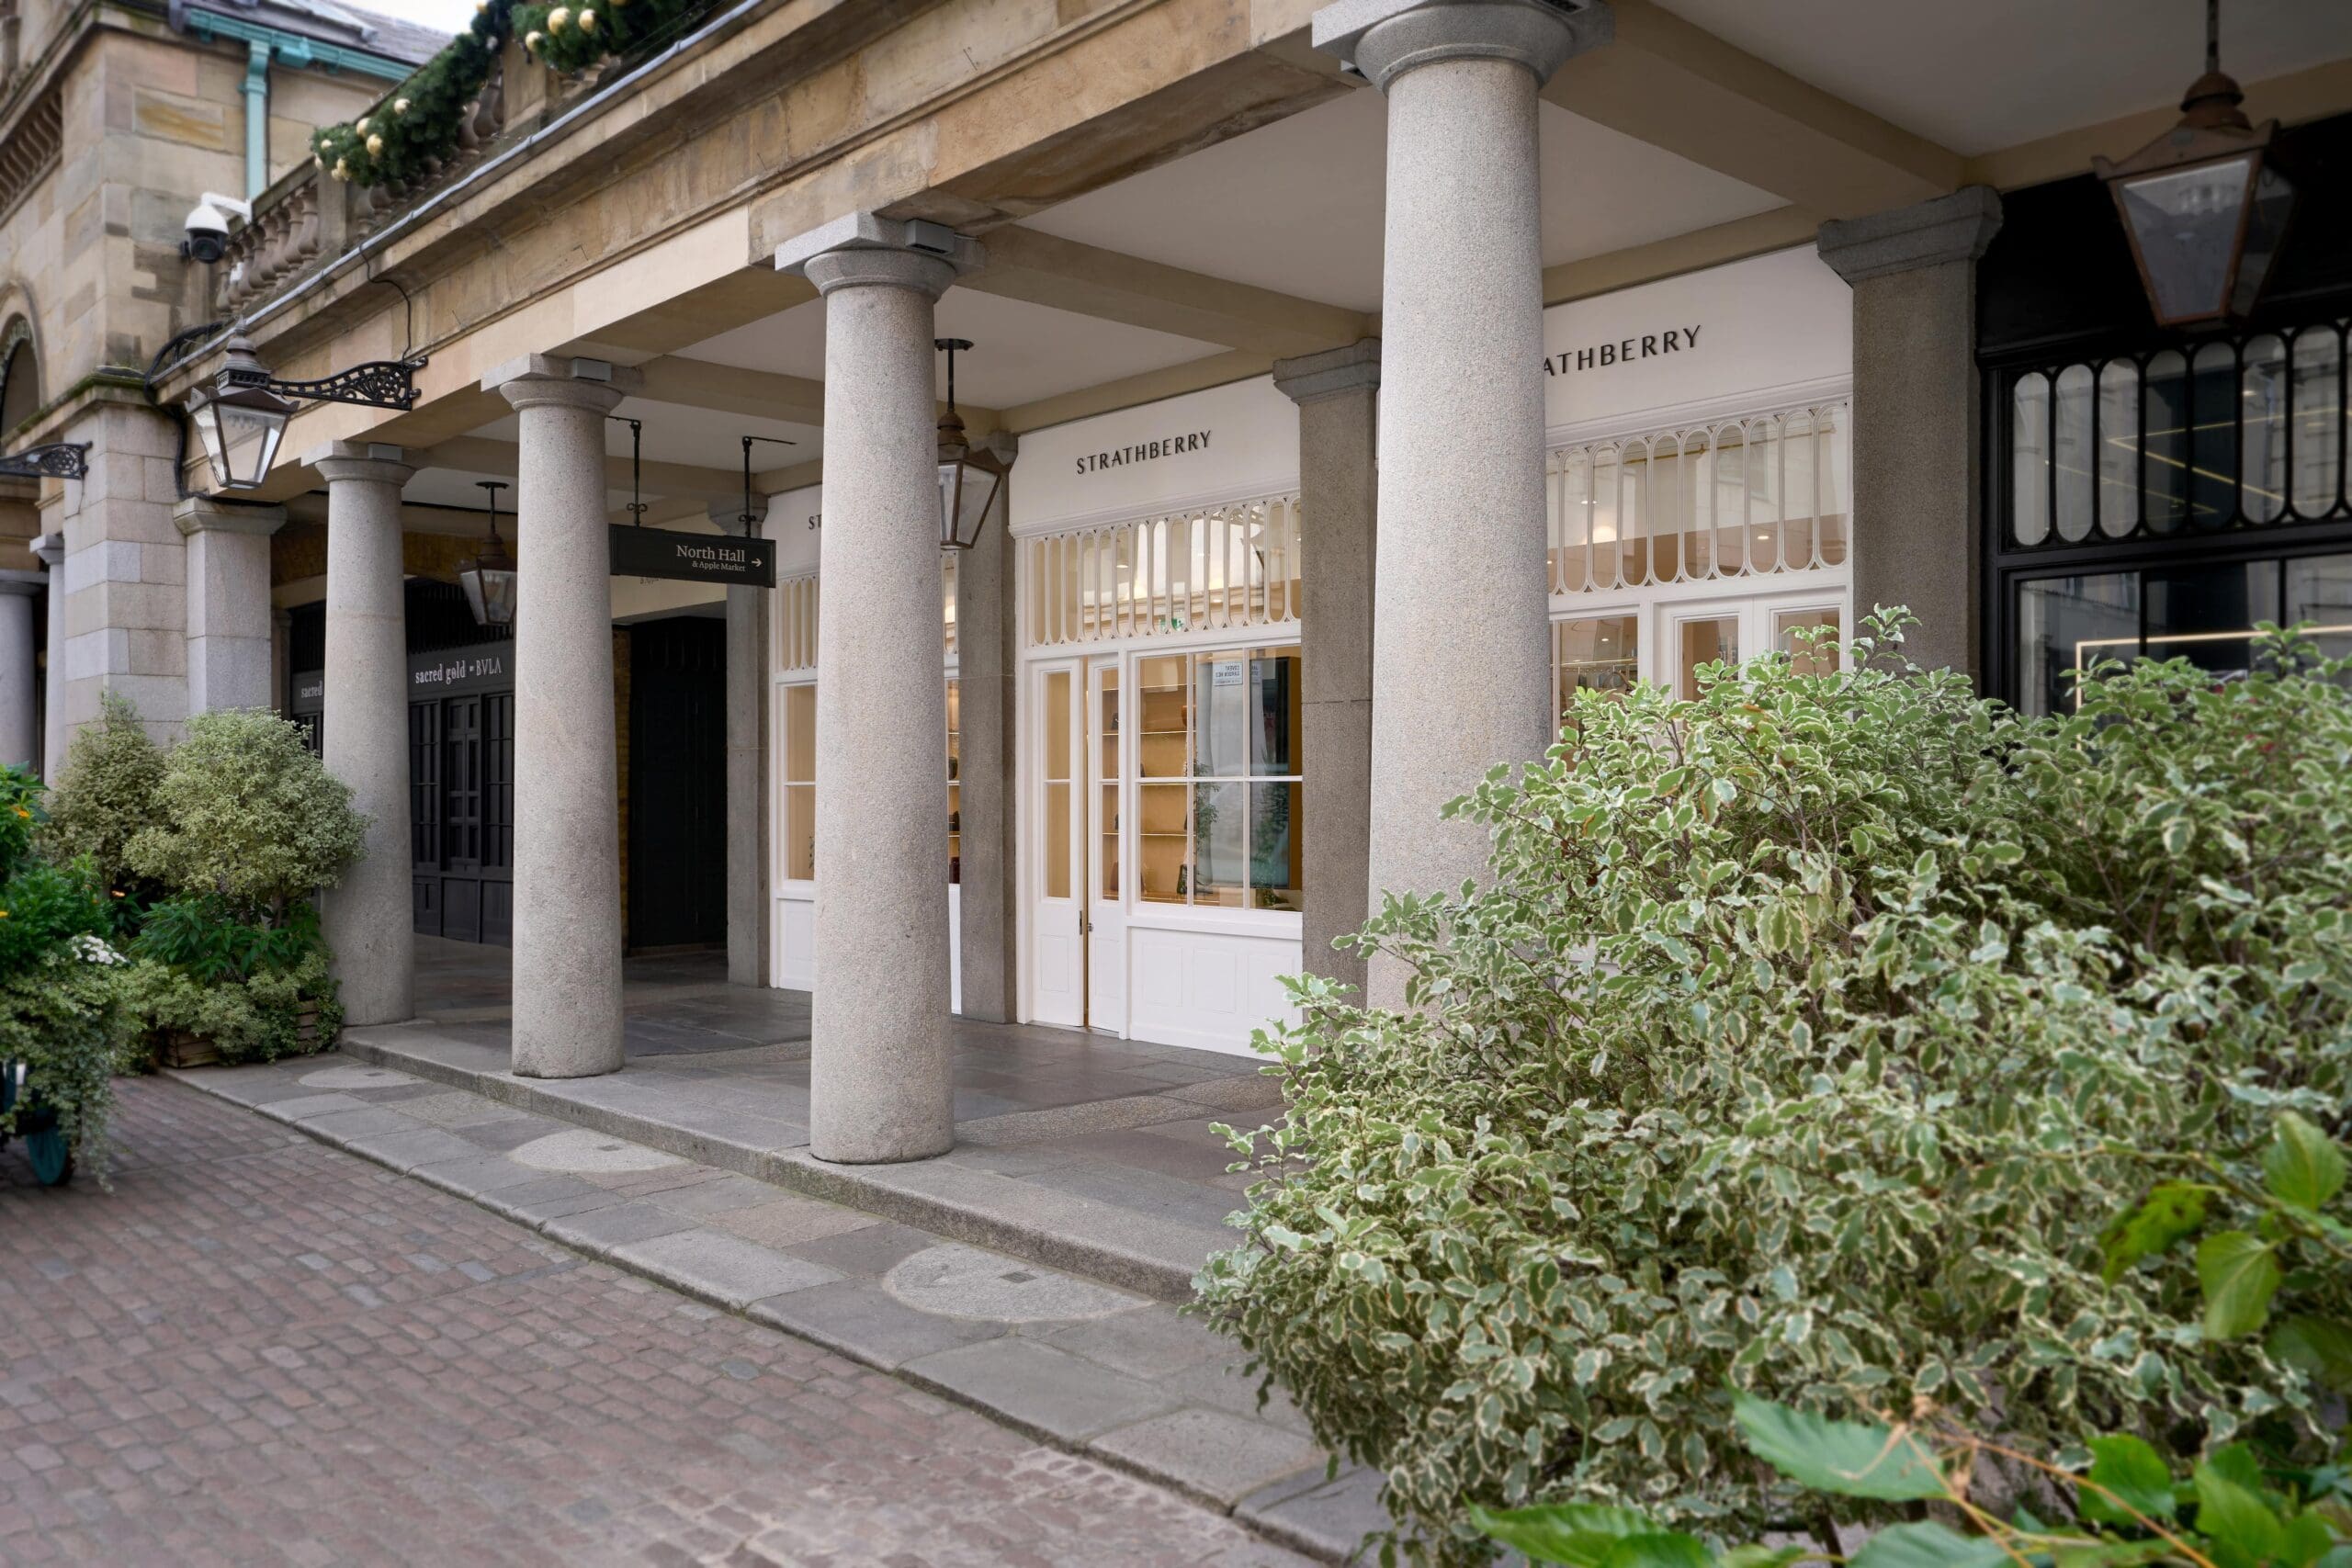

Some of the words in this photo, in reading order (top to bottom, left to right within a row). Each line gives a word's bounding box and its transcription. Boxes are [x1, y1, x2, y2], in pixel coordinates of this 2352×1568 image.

[1076, 430, 1211, 475] STRATHBERRY
[676, 544, 716, 559] North
[718, 548, 745, 562] Hall
[699, 561, 719, 570] Apple
[720, 562, 745, 571] Market
[415, 663, 443, 683] sacred
[446, 660, 466, 684] gold
